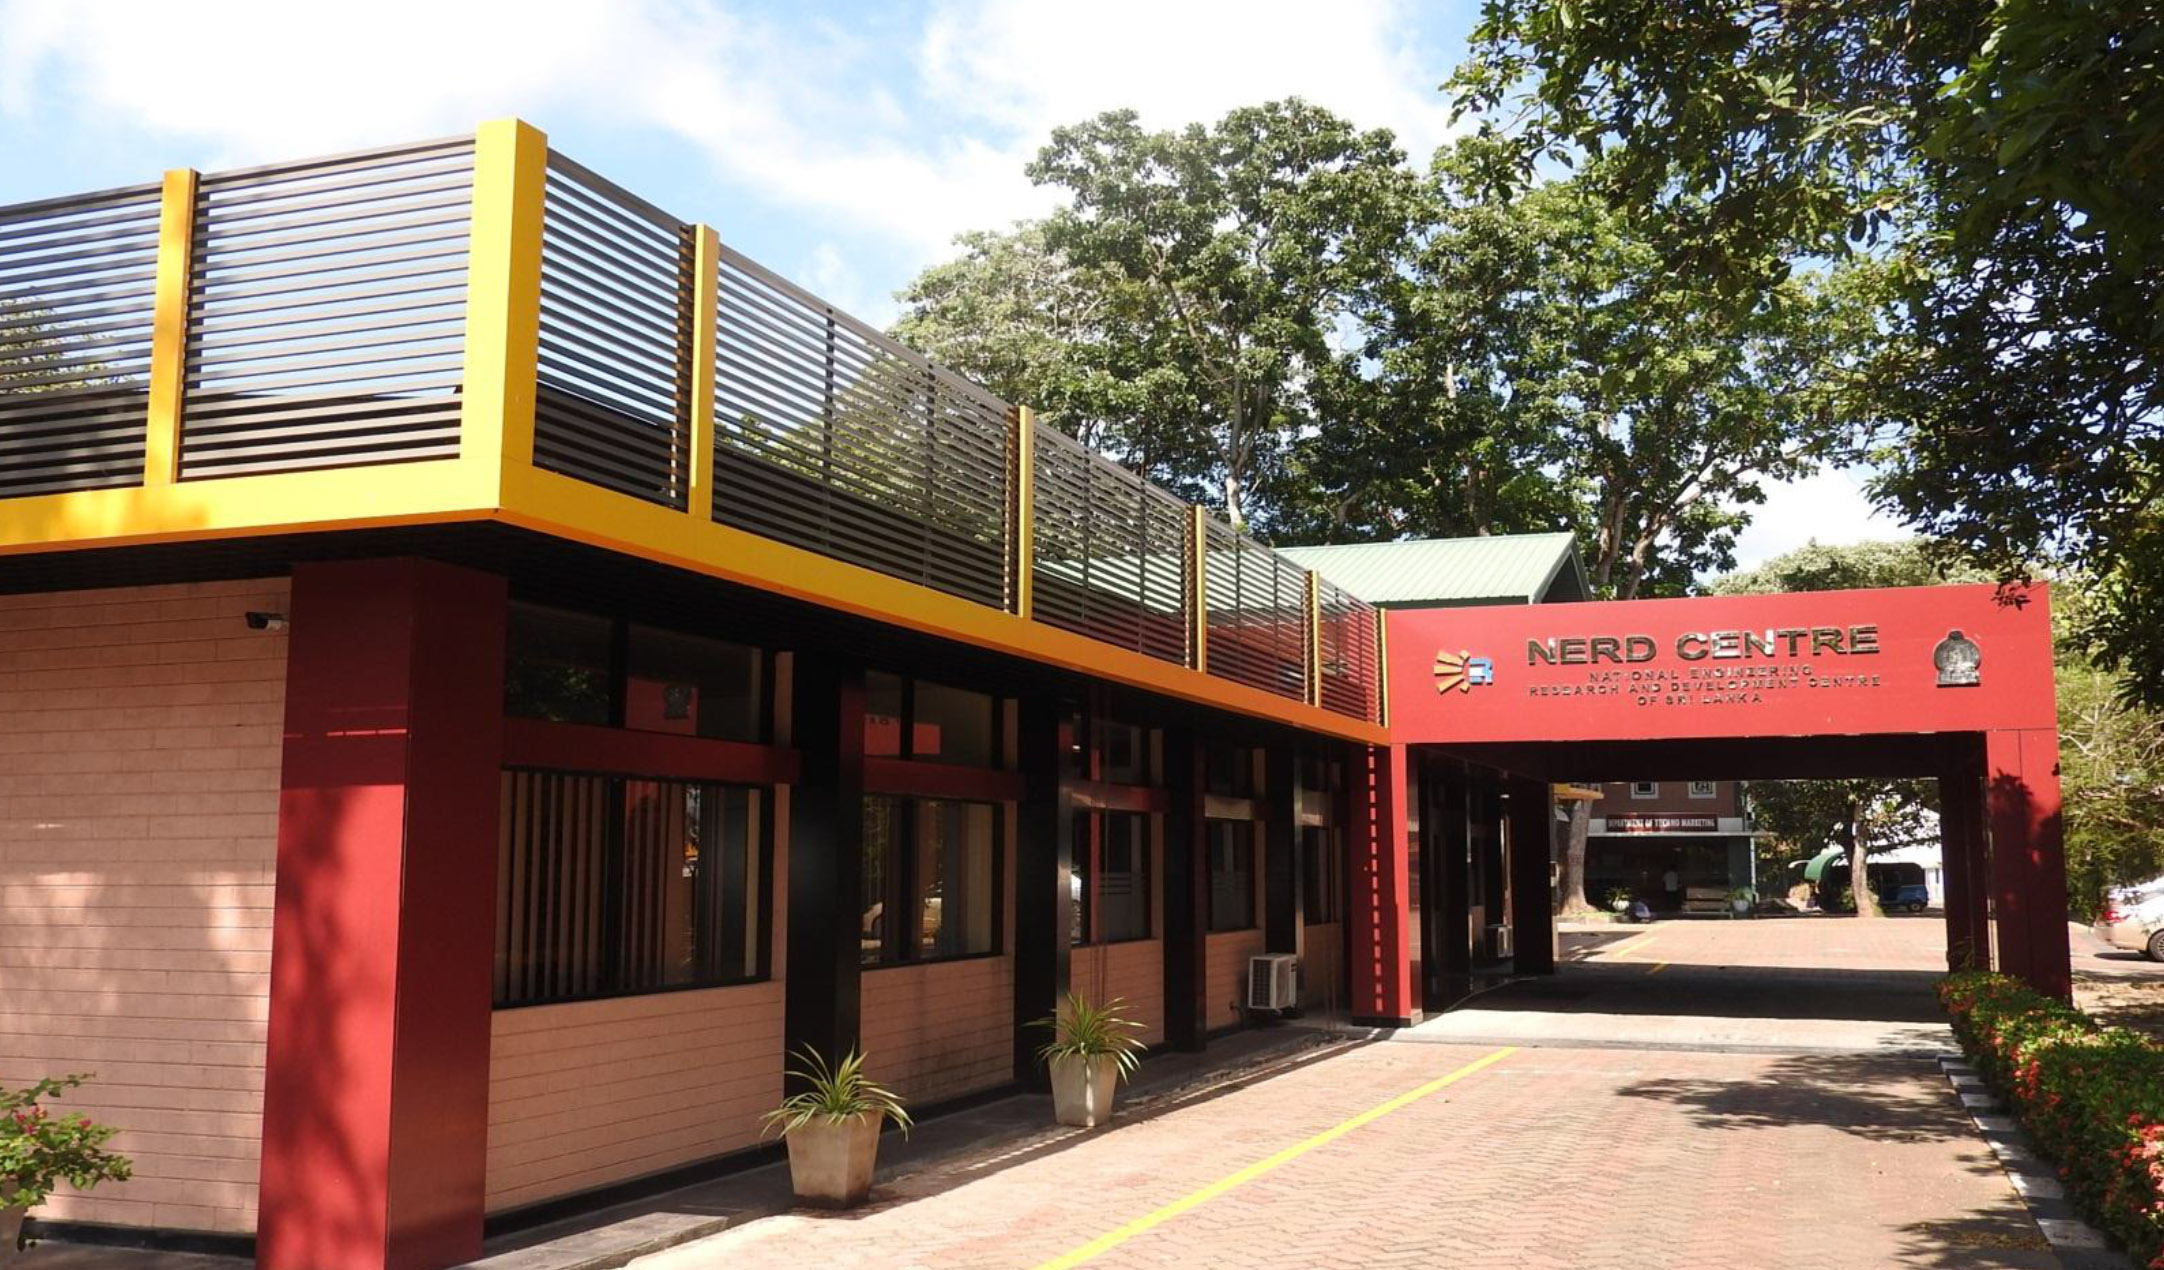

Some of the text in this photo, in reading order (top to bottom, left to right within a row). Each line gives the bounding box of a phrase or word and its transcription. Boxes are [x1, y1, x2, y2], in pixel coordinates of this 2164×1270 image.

[1528, 625, 1880, 666] NERD CENTRE
[1589, 665, 1812, 682] NATIONAL ENGINEERING
[1529, 676, 1880, 697] RESEARCH AND DEVELOPMENT CENTRE
[1637, 693, 1763, 706] OF SRI LANKA
